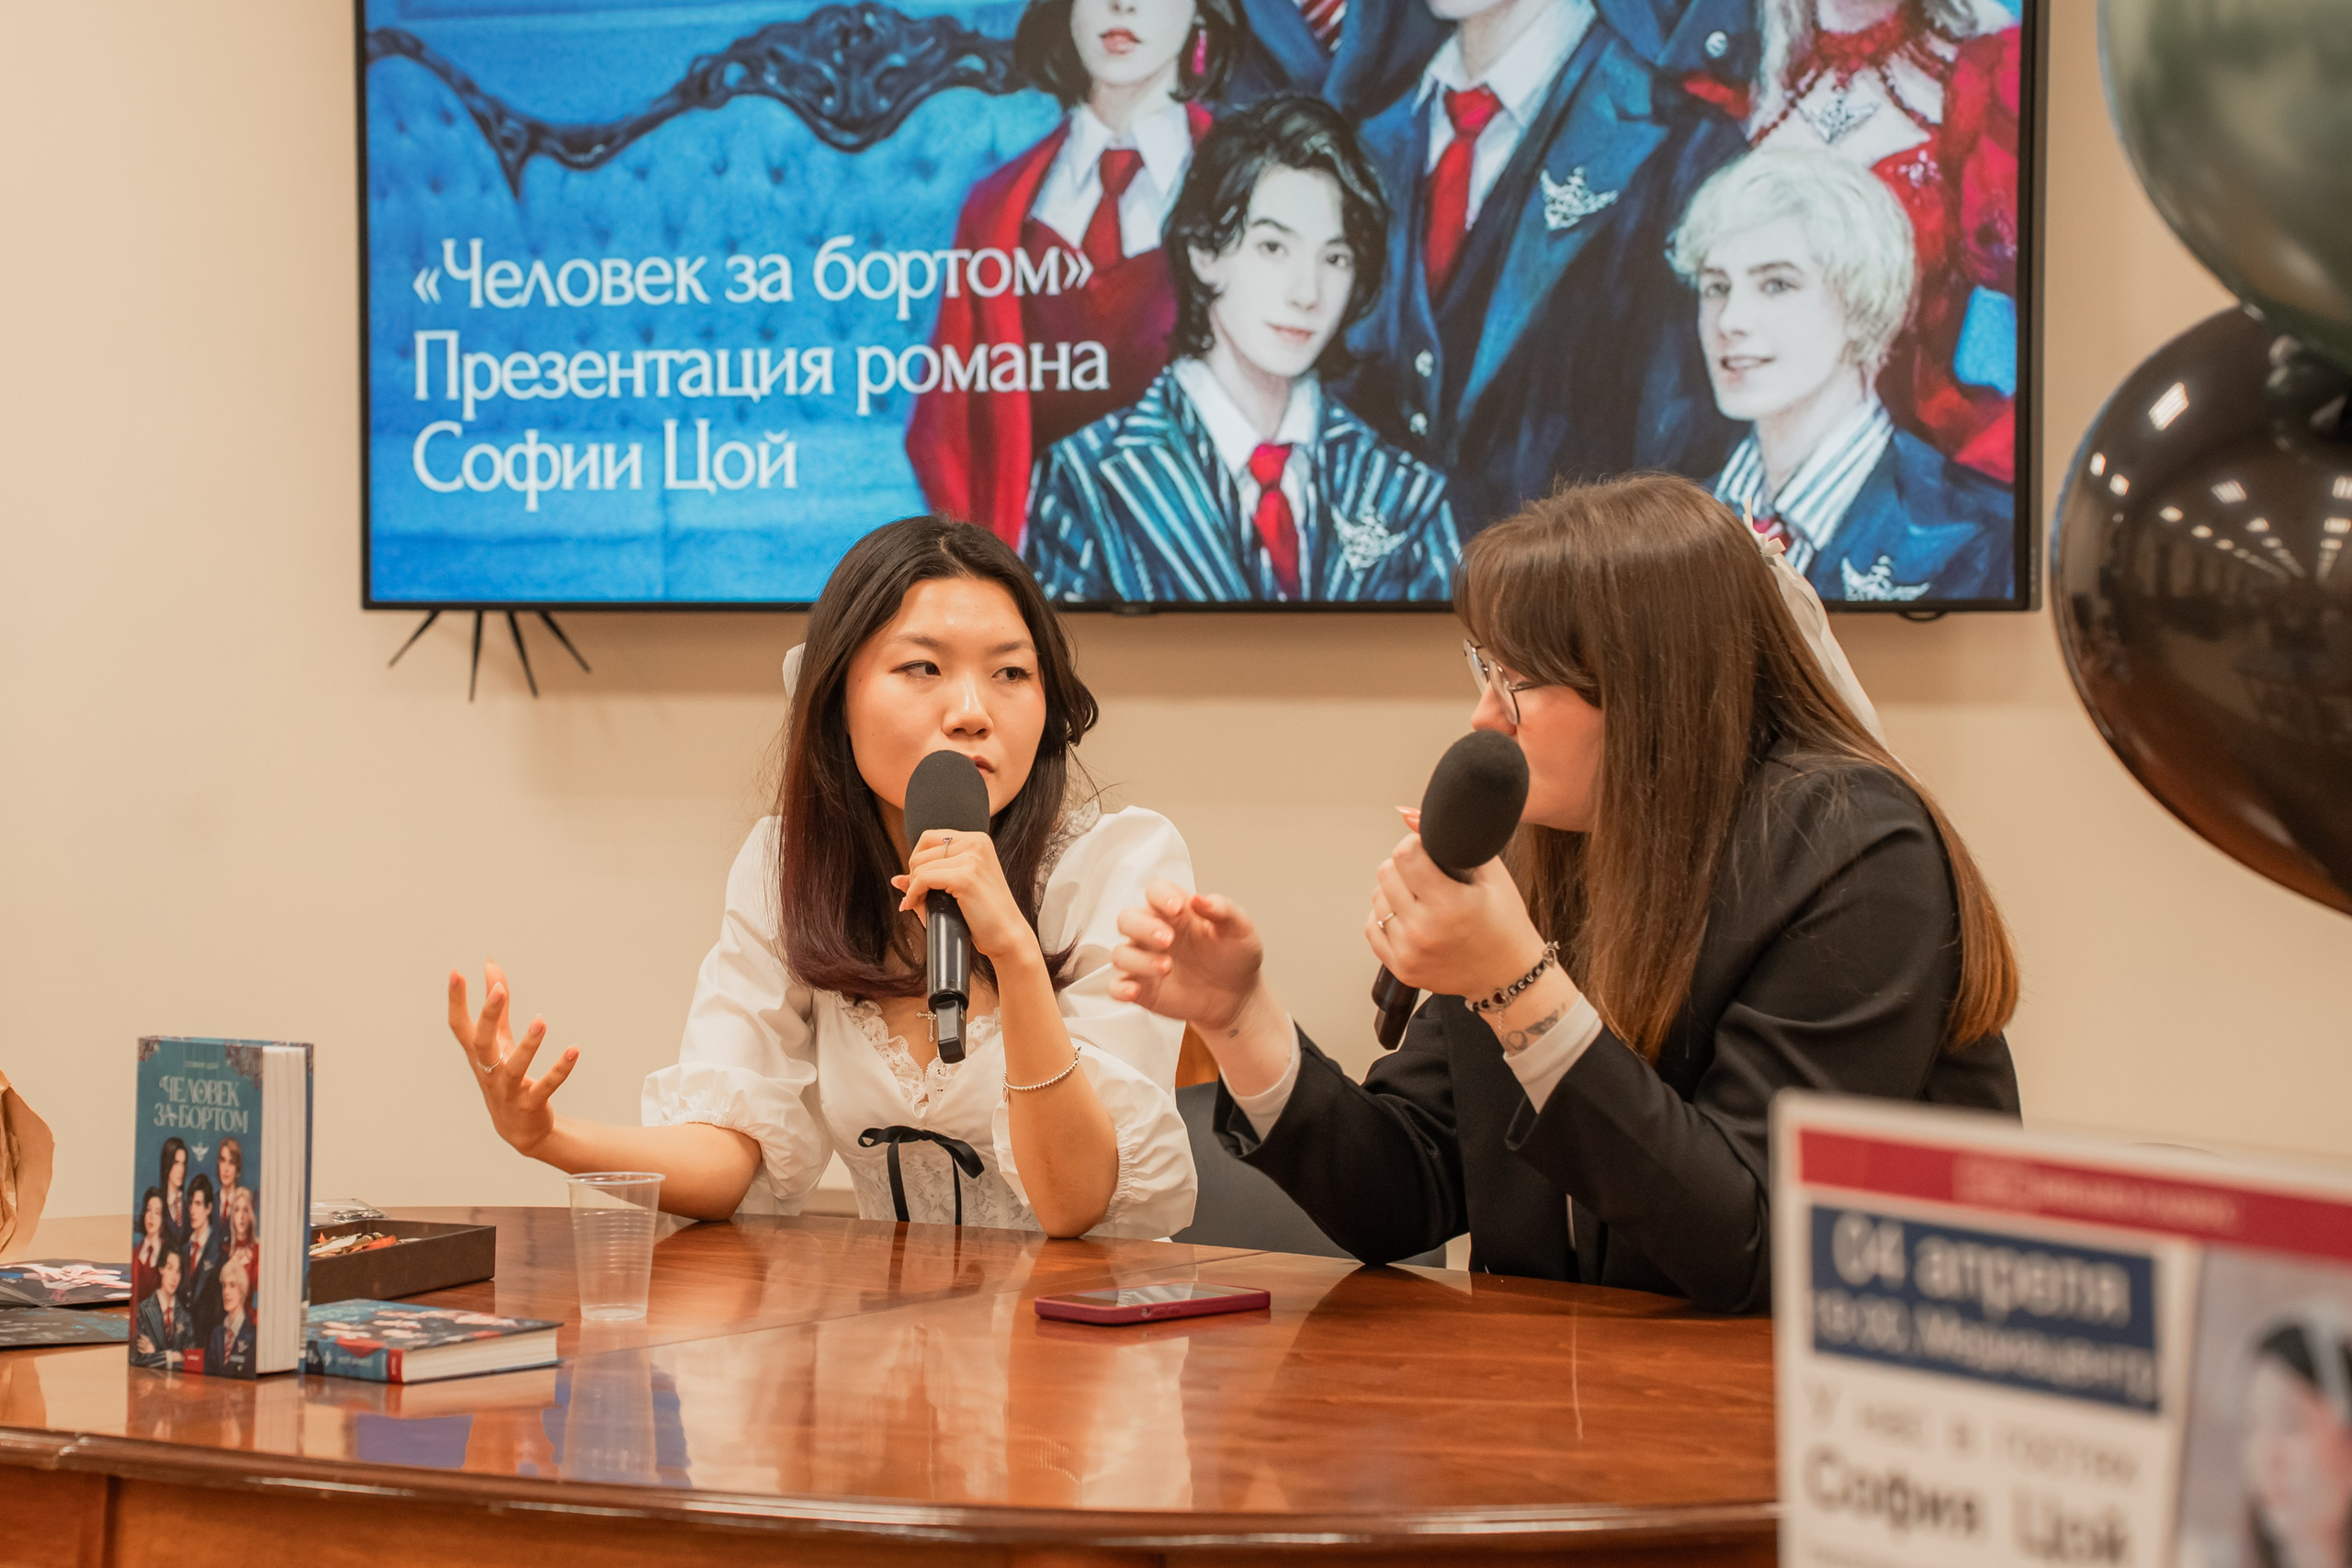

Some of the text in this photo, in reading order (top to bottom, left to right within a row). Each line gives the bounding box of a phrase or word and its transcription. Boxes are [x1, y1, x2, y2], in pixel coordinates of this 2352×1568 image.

[413, 235, 1094, 321] «Человек за бортом»
[413, 330, 1110, 422] Презентация романа
[413, 418, 798, 513] Софии Цой
[159, 1075, 240, 1108] ЧЕЛОВЕК
